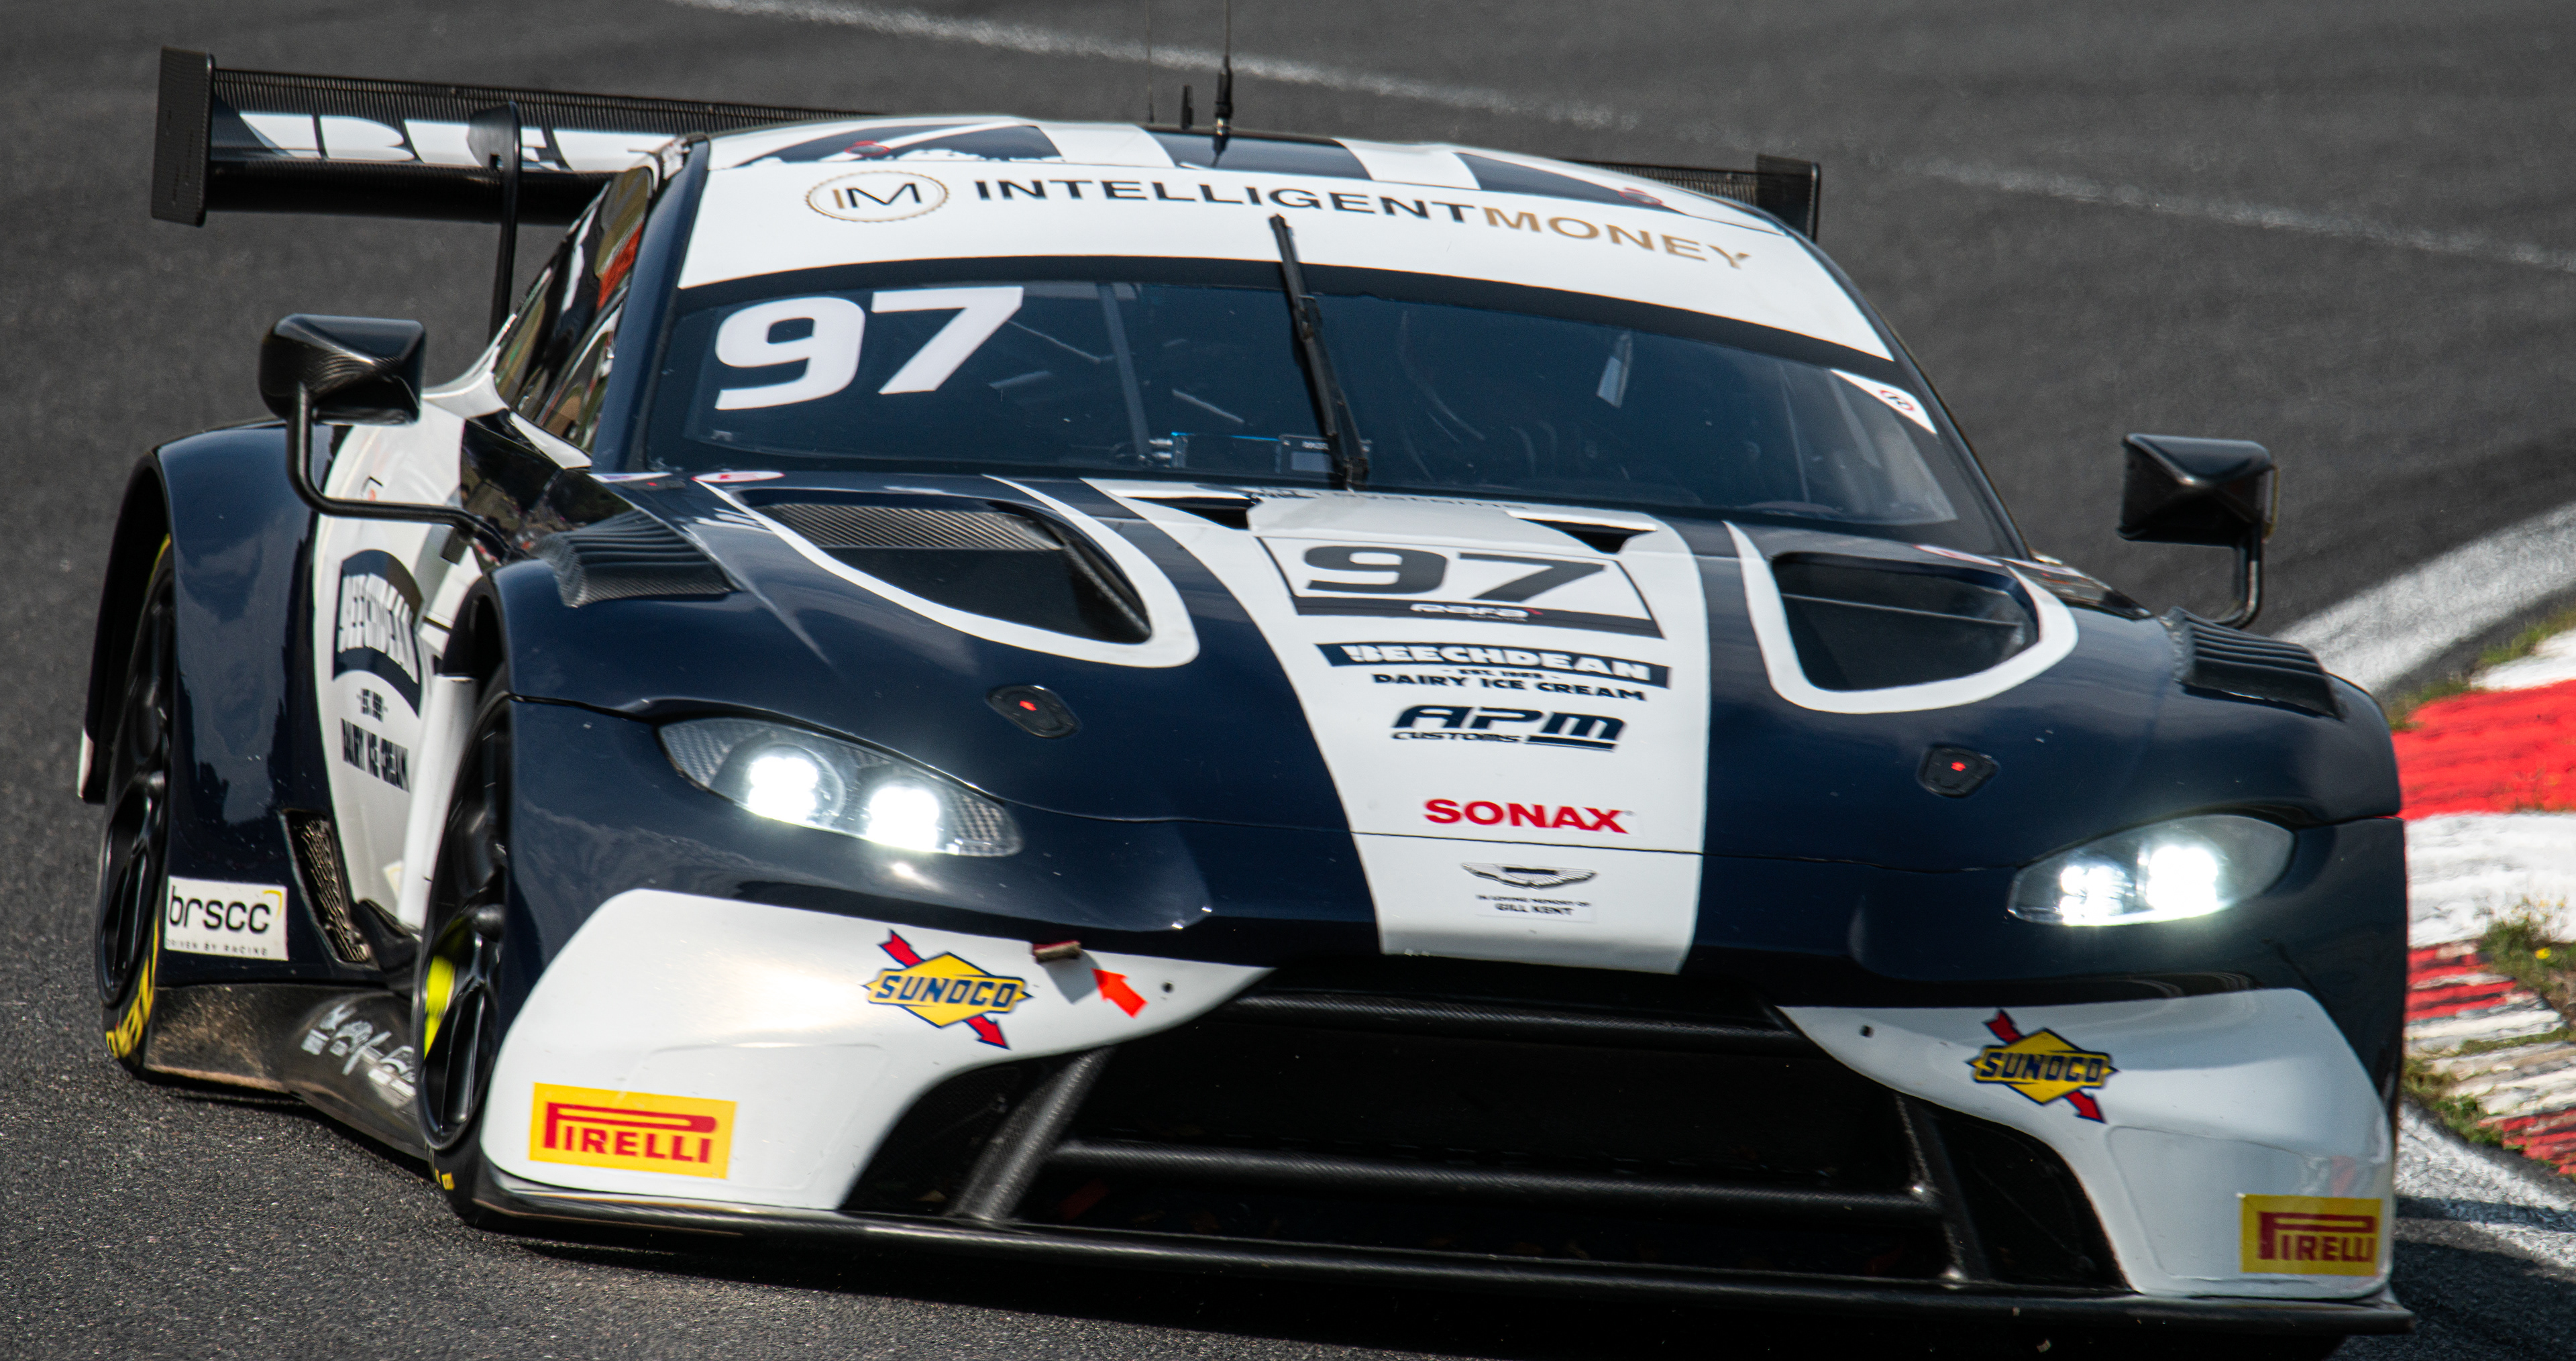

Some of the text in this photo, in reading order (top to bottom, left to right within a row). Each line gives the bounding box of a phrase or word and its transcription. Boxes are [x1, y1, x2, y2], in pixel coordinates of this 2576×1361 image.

[833, 183, 922, 209] IM
[714, 286, 1024, 410] 97
[1303, 545, 1607, 602] 97
[1342, 645, 1651, 680] BEECHDEAN
[1371, 673, 1647, 702] DAIRY ICE CREAM
[1423, 798, 1630, 834] SONAX
[169, 885, 270, 934] brscc
[875, 975, 1018, 1008] SUNOCO
[1980, 1052, 2104, 1083] SUNOCO
[542, 1101, 718, 1164] PIRELLI
[2257, 1211, 2377, 1263] PIRELLI
